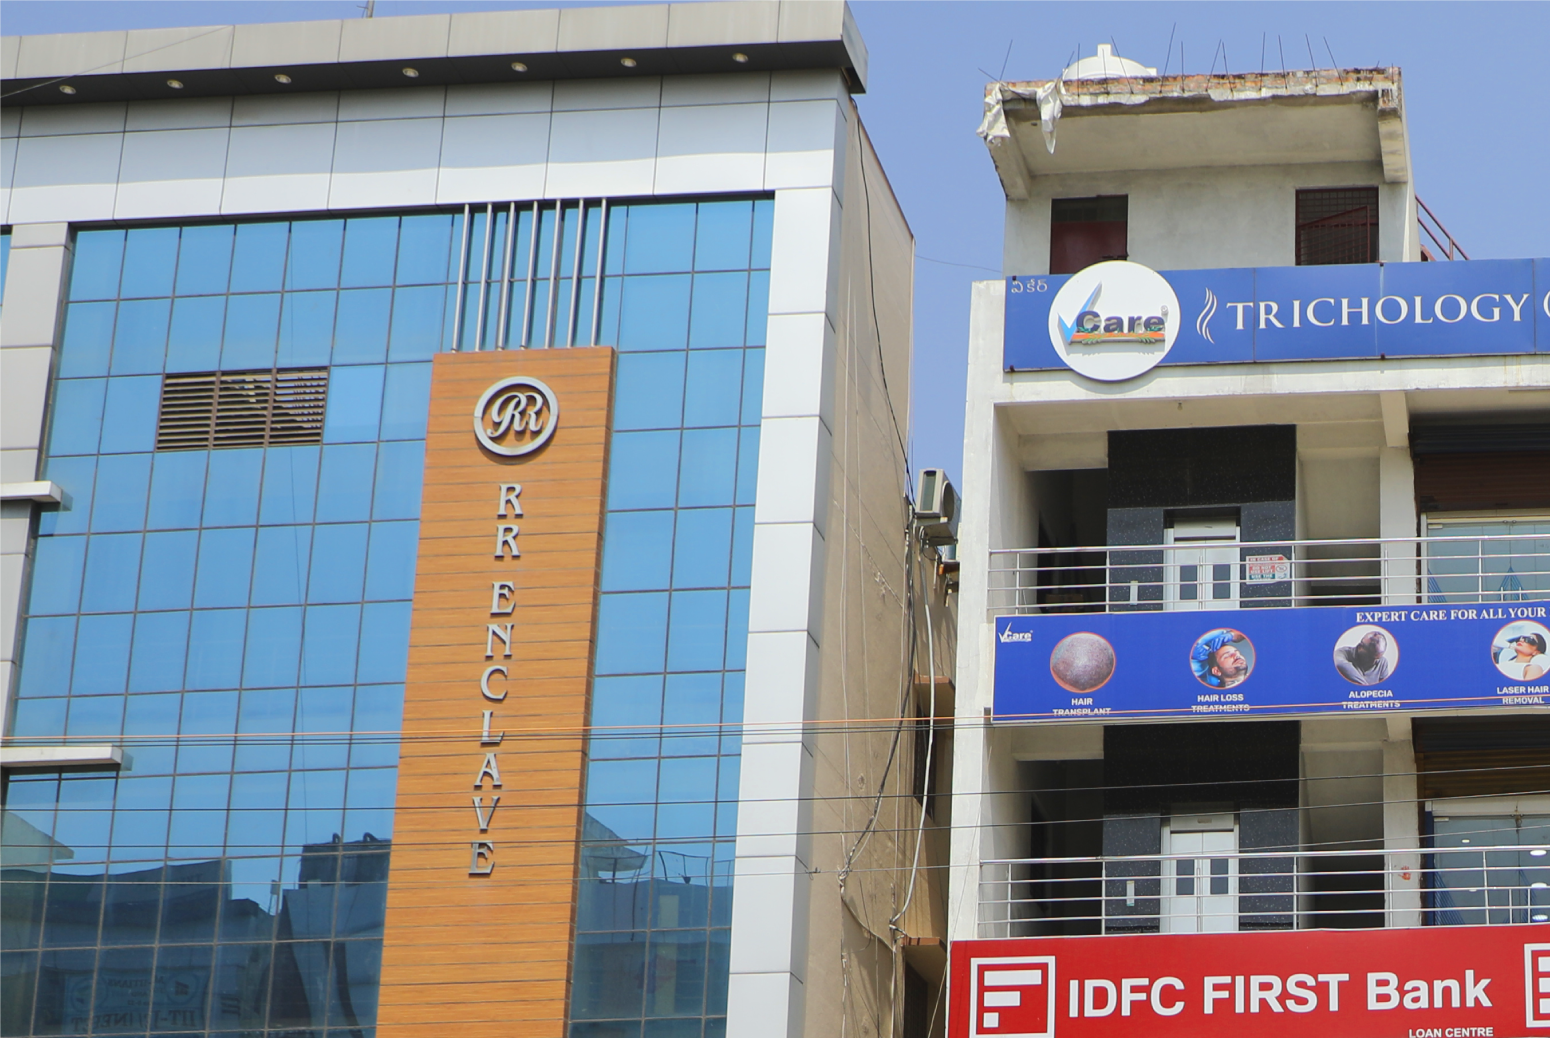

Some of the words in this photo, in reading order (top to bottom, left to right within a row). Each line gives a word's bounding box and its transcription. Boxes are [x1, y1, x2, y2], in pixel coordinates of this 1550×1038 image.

[1226, 293, 1529, 331] TRICHOLOGY
[1355, 610, 1407, 623] EXPERT
[1410, 609, 1447, 622] CARE
[1450, 608, 1477, 621] FOR
[1479, 607, 1507, 620] ALL
[1508, 606, 1547, 619] YOUR
[1348, 690, 1394, 699] ALOPECIA
[1497, 686, 1524, 695] LASER
[1527, 685, 1550, 694] HAIR
[1071, 697, 1093, 707] HAIR
[1197, 694, 1218, 703] HAIR
[1220, 693, 1244, 702] LOSS
[1502, 696, 1545, 705] REMOVAL
[1192, 704, 1250, 714] TREATMENTS
[1342, 700, 1400, 710] TREATMENTS
[1052, 708, 1112, 718] TRANSPLANT
[1068, 976, 1186, 1018] IDFC
[1203, 973, 1350, 1015] FIRST
[1366, 969, 1494, 1011] Bank
[1445, 1026, 1495, 1038] CENTRE
